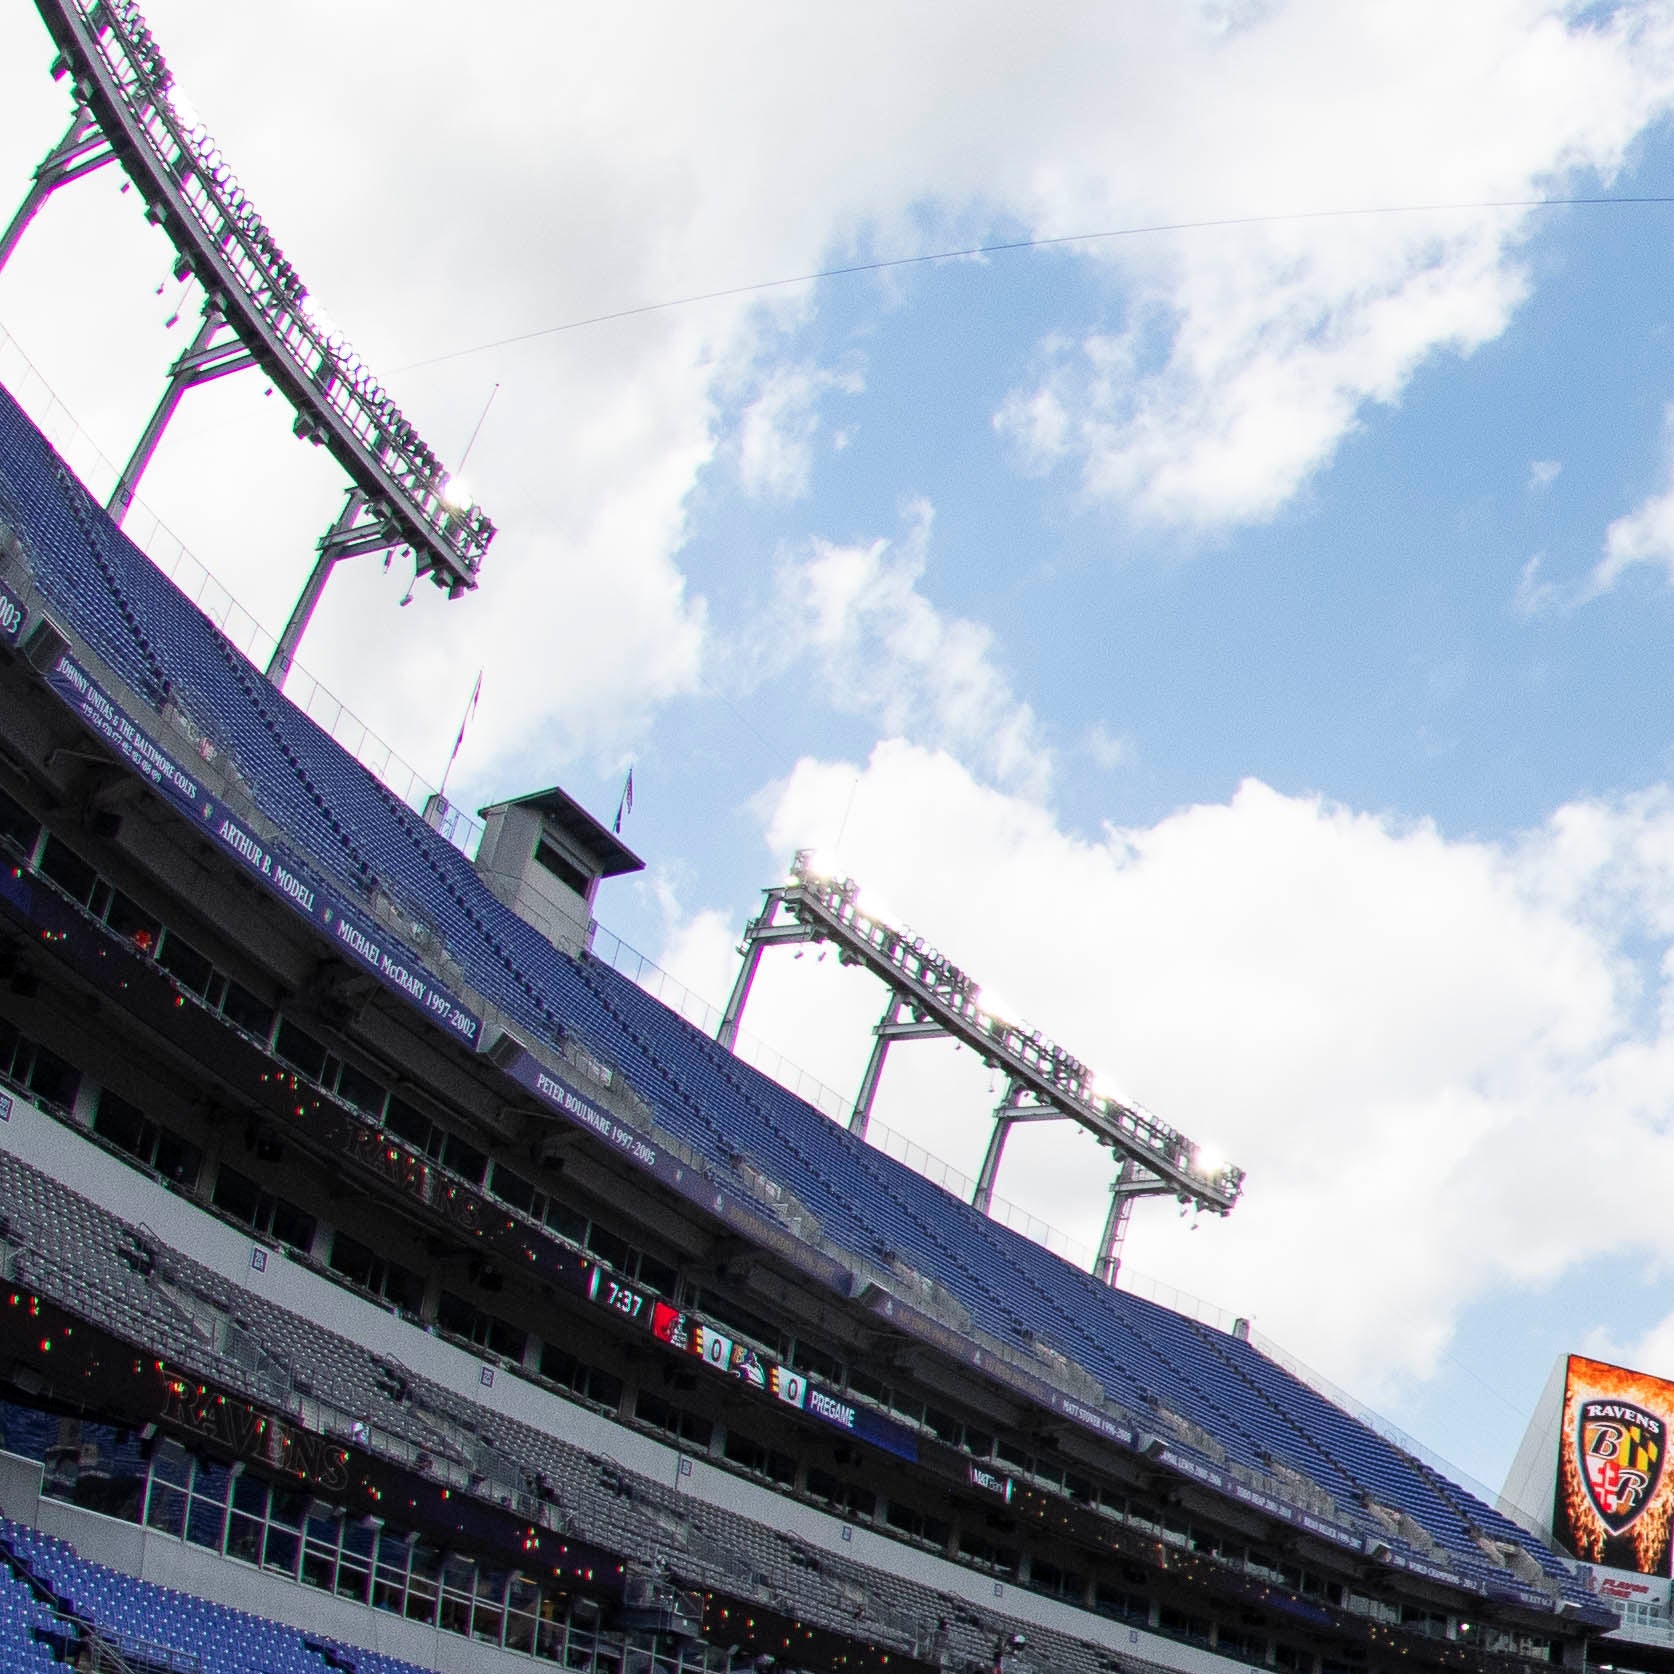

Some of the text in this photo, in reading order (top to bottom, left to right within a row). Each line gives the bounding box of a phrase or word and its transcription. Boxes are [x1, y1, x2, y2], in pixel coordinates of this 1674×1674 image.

[56, 656, 90, 701] JOHNNY
[119, 717, 136, 742] THE
[134, 729, 175, 780] BALTIMORE
[174, 770, 198, 800] COLTS
[219, 819, 315, 912] ARTHUR B. MODELL
[337, 919, 477, 1040] MICHAEL McCRARY 1997-2002
[537, 1072, 656, 1167] PETER BOULWARE 1997-2005
[607, 1282, 643, 1318] 7:37
[711, 1338, 856, 1428] 0 0 PREGAME
[1586, 1404, 1661, 1435] RAVENS
